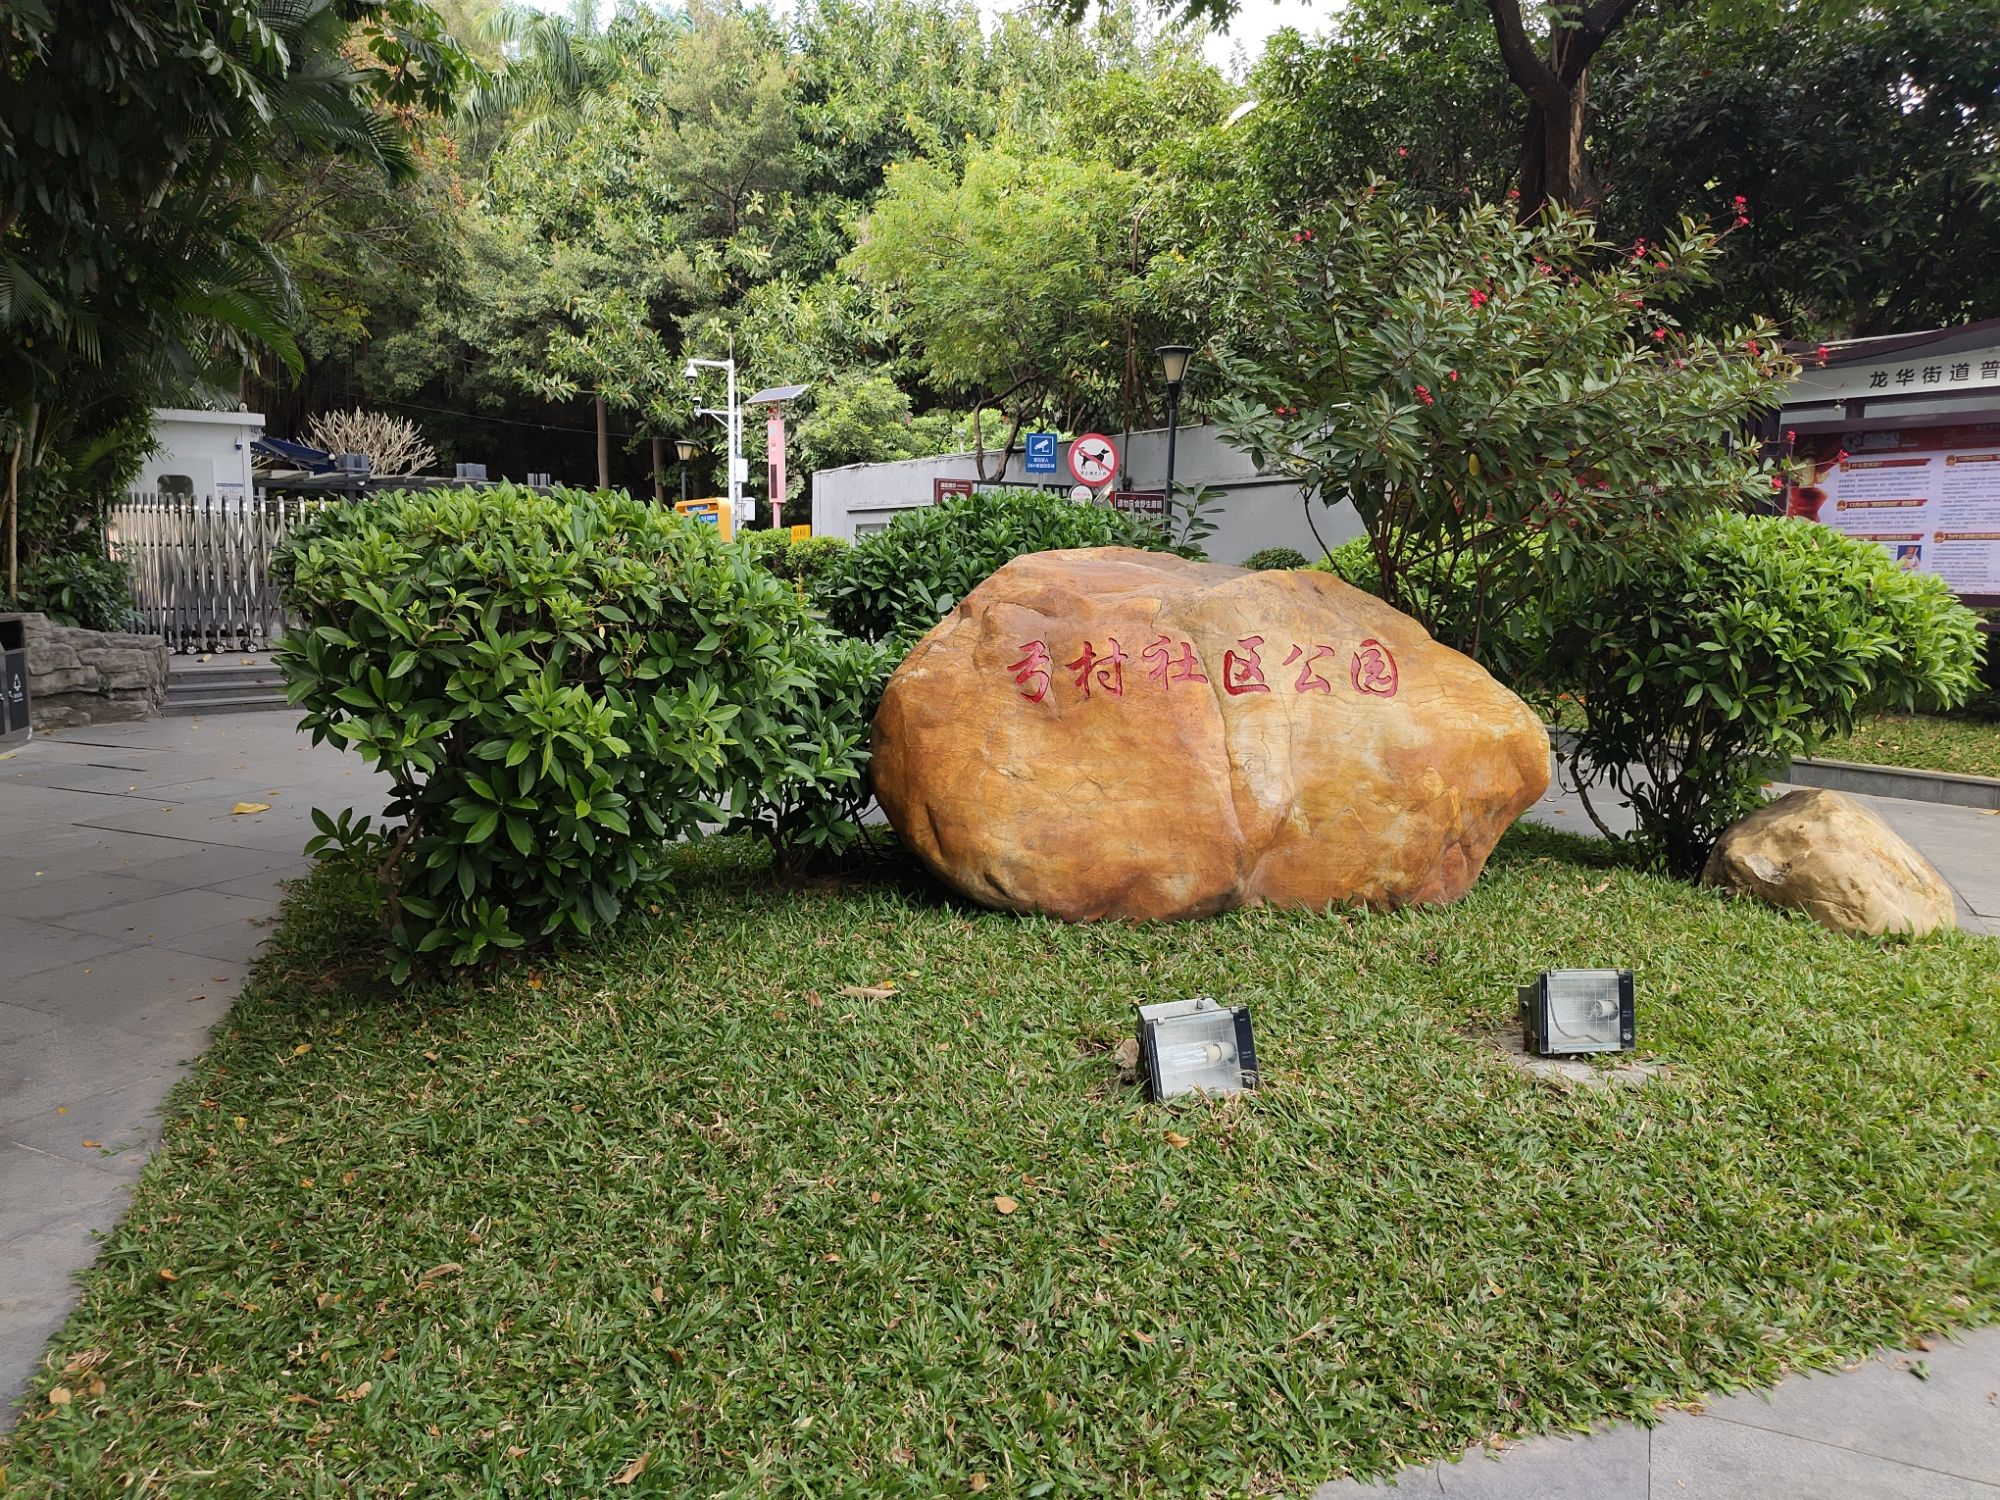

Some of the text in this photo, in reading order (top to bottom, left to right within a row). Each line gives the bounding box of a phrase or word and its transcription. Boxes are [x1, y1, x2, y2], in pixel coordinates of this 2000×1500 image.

[1869, 360, 2000, 388] 龙华街道普
